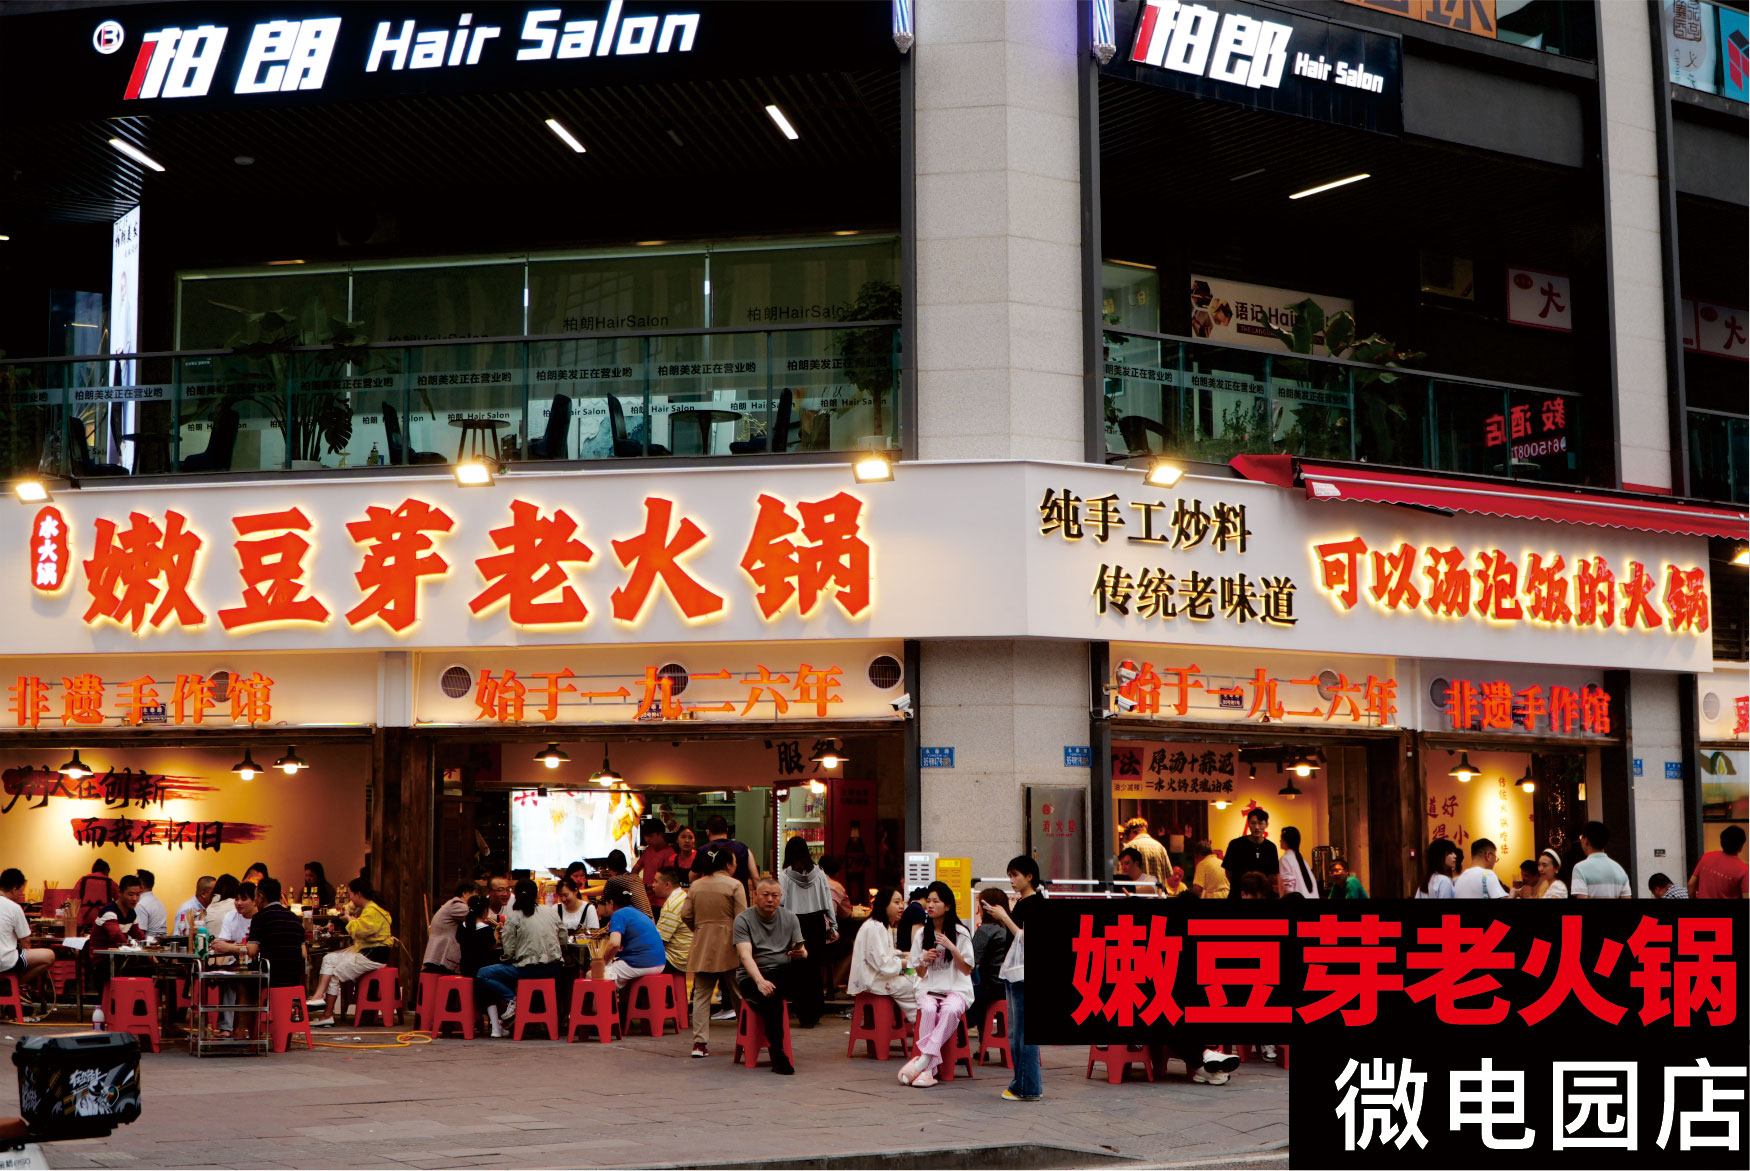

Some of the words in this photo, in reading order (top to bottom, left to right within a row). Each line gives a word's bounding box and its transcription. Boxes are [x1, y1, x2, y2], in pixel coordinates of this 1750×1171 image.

[123, 17, 342, 100] 柏朗
[365, 12, 501, 72] Hair
[516, 0, 700, 61] Salon
[1294, 52, 1332, 82] Hair
[1335, 61, 1384, 94] Salon
[564, 314, 669, 332] 柏朗HairSalon
[746, 305, 846, 321] 柏朗HairSalo
[36, 514, 59, 587] 水火锅
[1039, 487, 1252, 553] 纯手工炒料
[82, 490, 871, 634] 嫩豆芽老火锅
[1313, 536, 1710, 634] 可以汤泡饭的火锅
[1093, 563, 1299, 627] 传统老味道
[8, 672, 275, 727] 非遗手作馆
[475, 663, 844, 722] 始于一九二六年
[1117, 660, 1398, 727] 始于一九二六年
[1444, 679, 1612, 735] 非遗手作馆
[77, 814, 224, 853] 而我在怀旧
